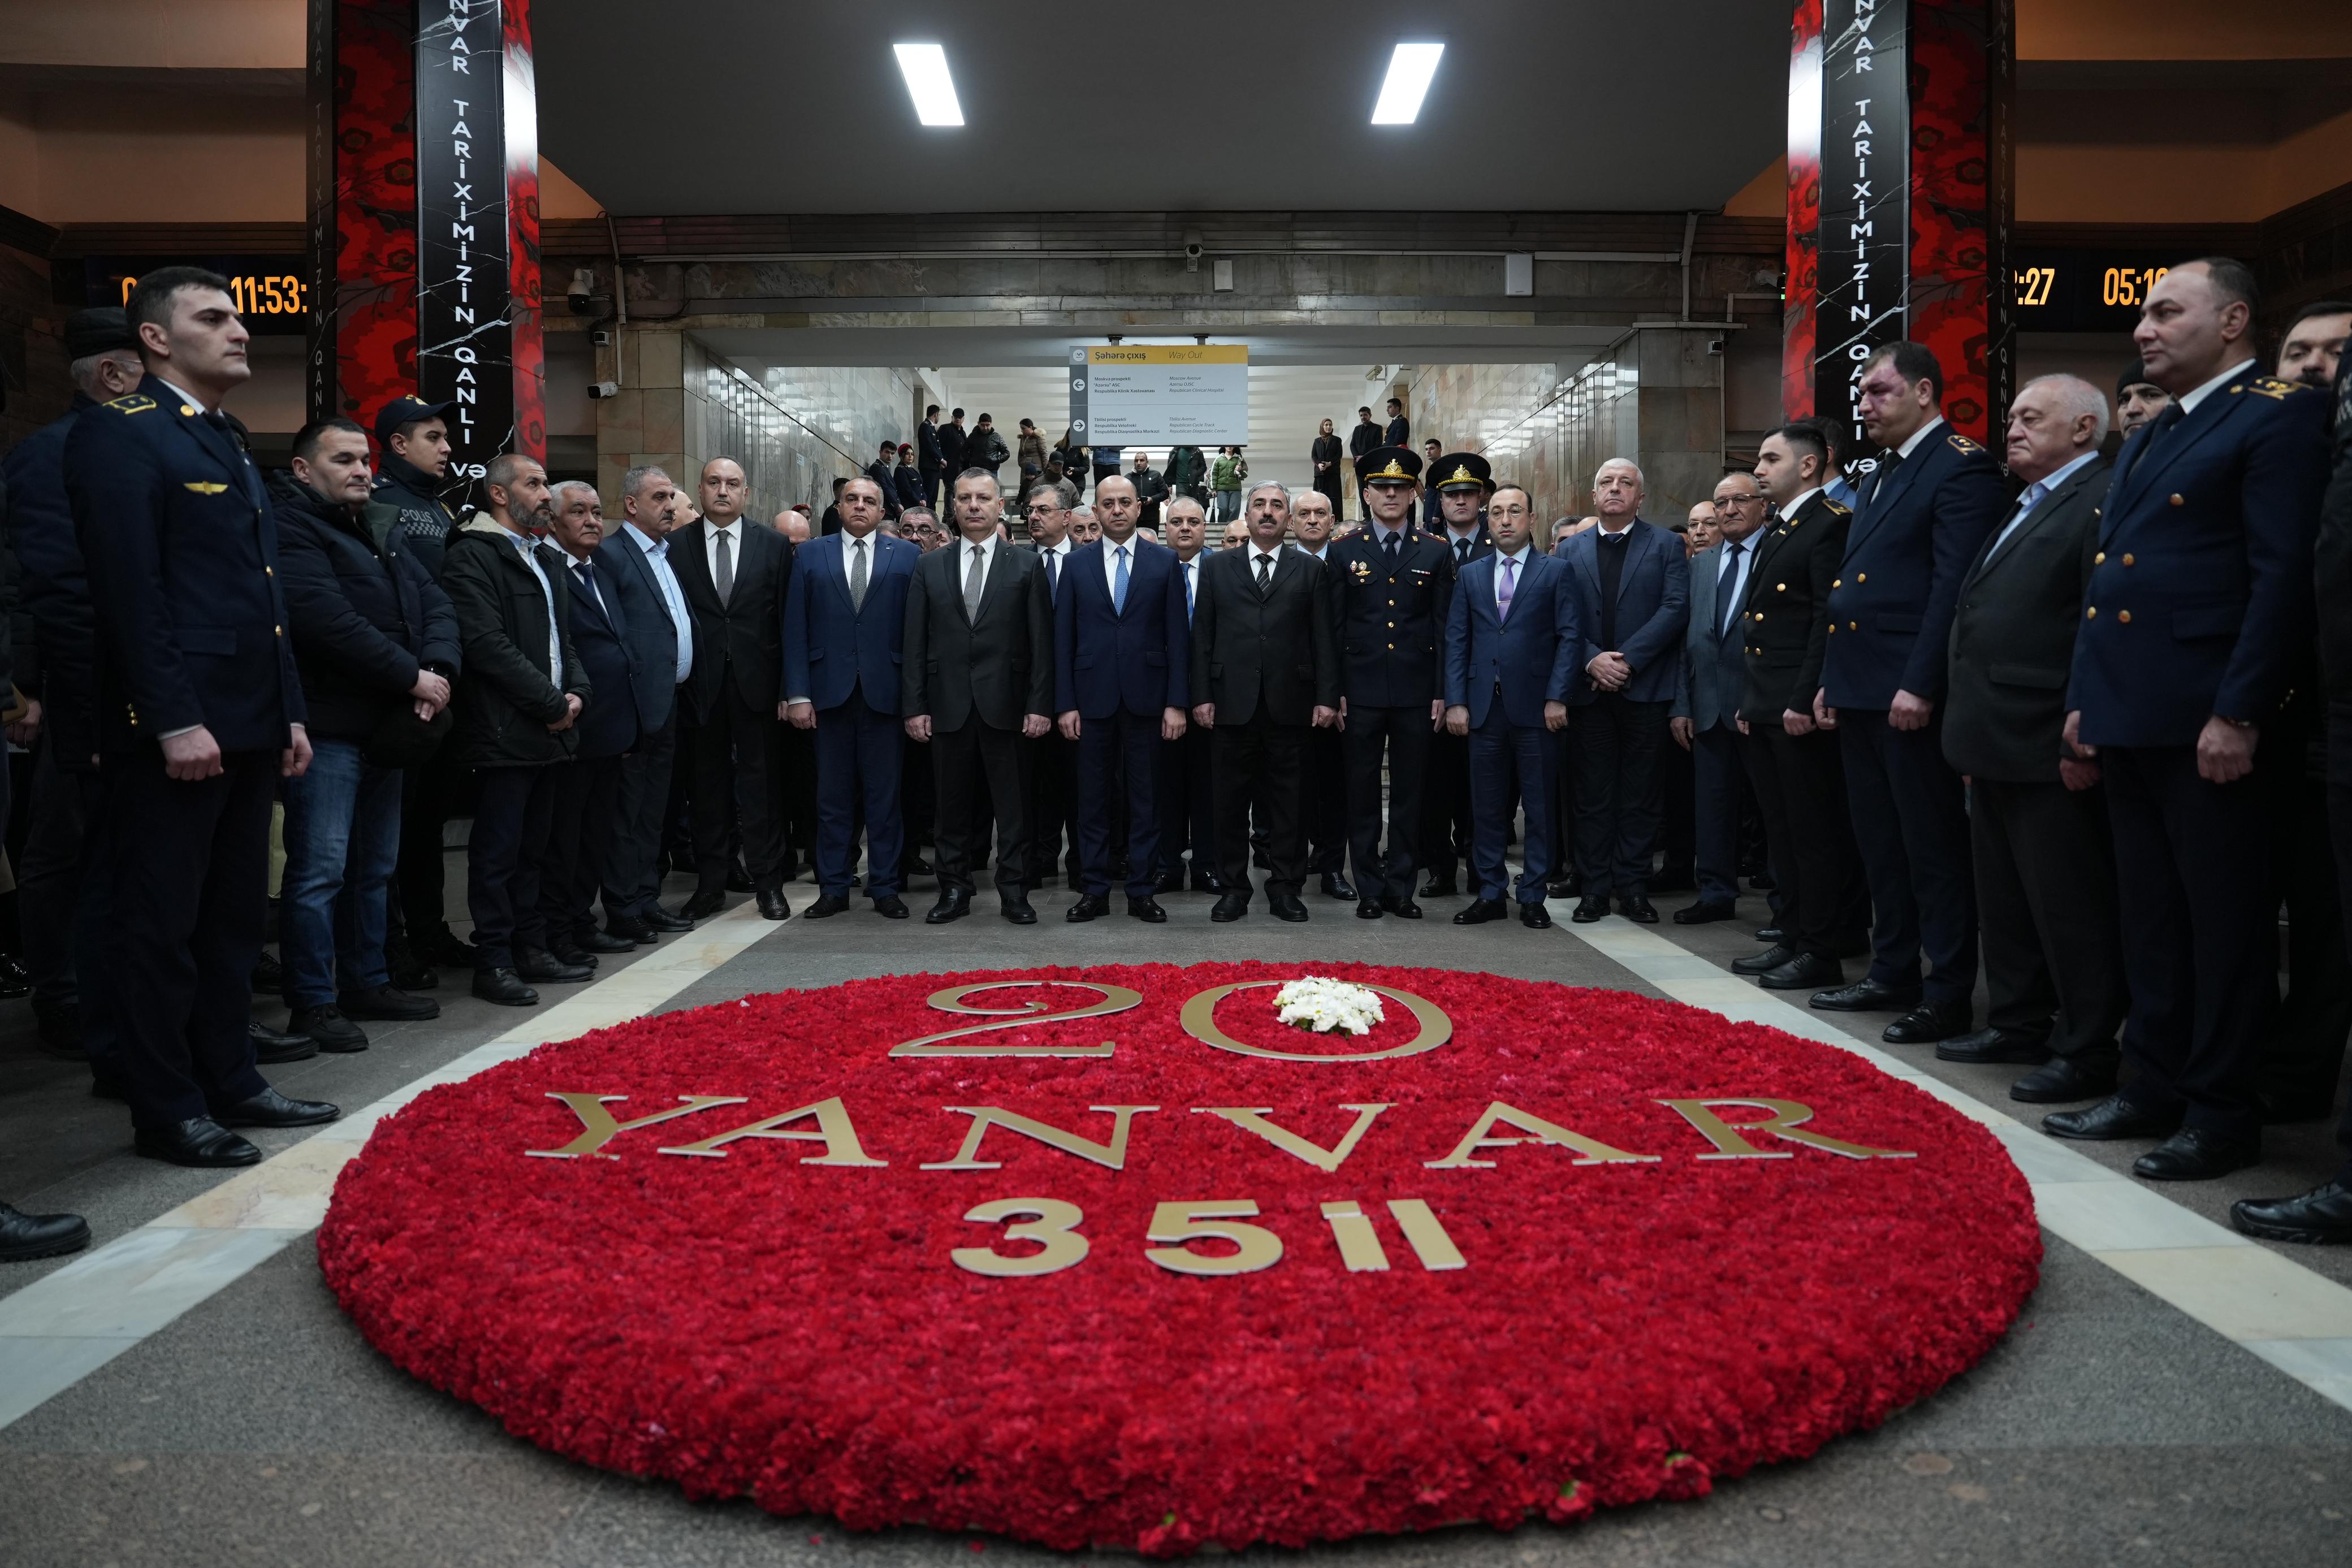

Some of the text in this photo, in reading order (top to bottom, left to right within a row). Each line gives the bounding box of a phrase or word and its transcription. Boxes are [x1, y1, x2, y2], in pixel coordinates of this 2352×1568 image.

[2014, 267, 2055, 305] :27
[1095, 352, 1125, 360] Şəhərə
[1169, 351, 1186, 360] Way
[2000, 347, 2008, 443] QANLI
[454, 347, 479, 444] QANLI
[888, 980, 1452, 1062] 20
[524, 1091, 1918, 1171] YANVAR
[950, 1197, 1283, 1276] 35
